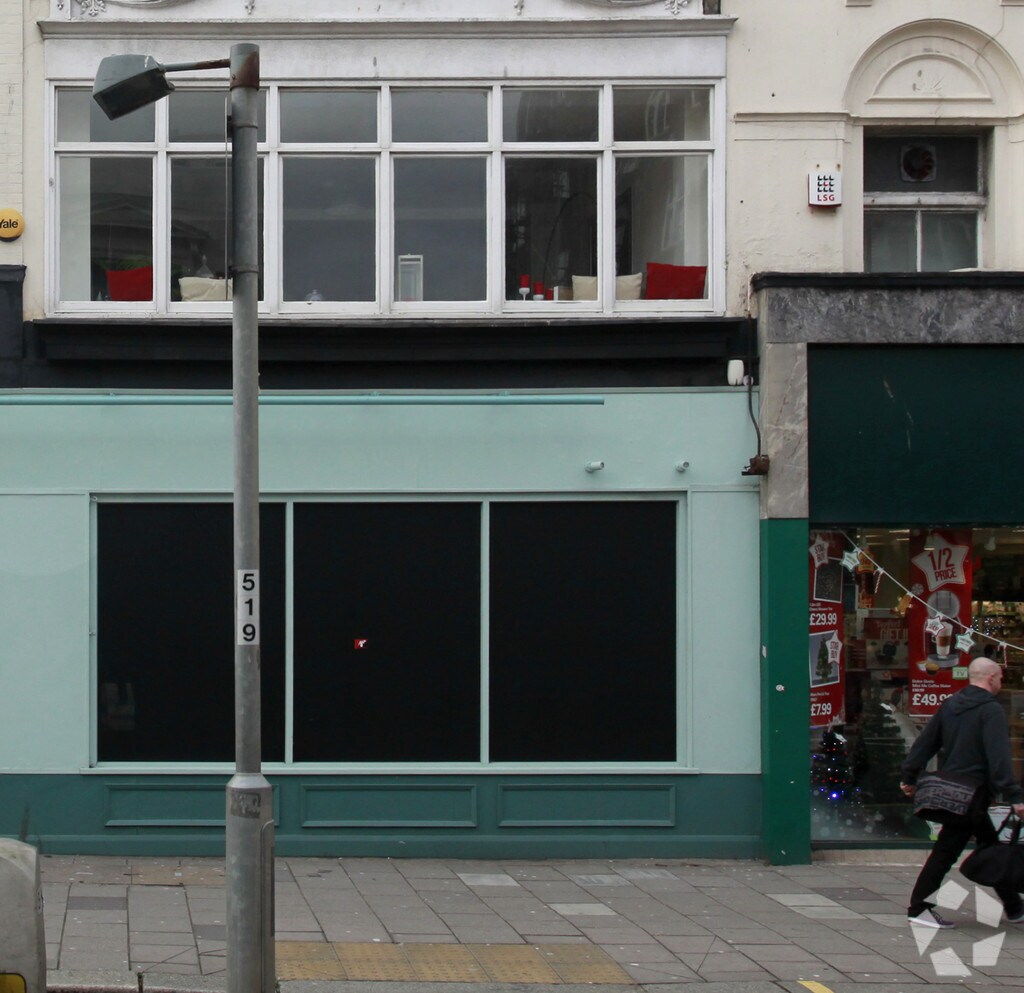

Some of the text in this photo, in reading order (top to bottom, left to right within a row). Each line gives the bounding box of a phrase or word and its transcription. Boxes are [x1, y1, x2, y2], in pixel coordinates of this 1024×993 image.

[817, 194, 835, 202] LSG
[928, 547, 955, 570] 1/2
[934, 567, 957, 582] PRICE
[241, 572, 257, 643] 519
[809, 612, 837, 626] £29.99
[810, 702, 832, 716] £7.99
